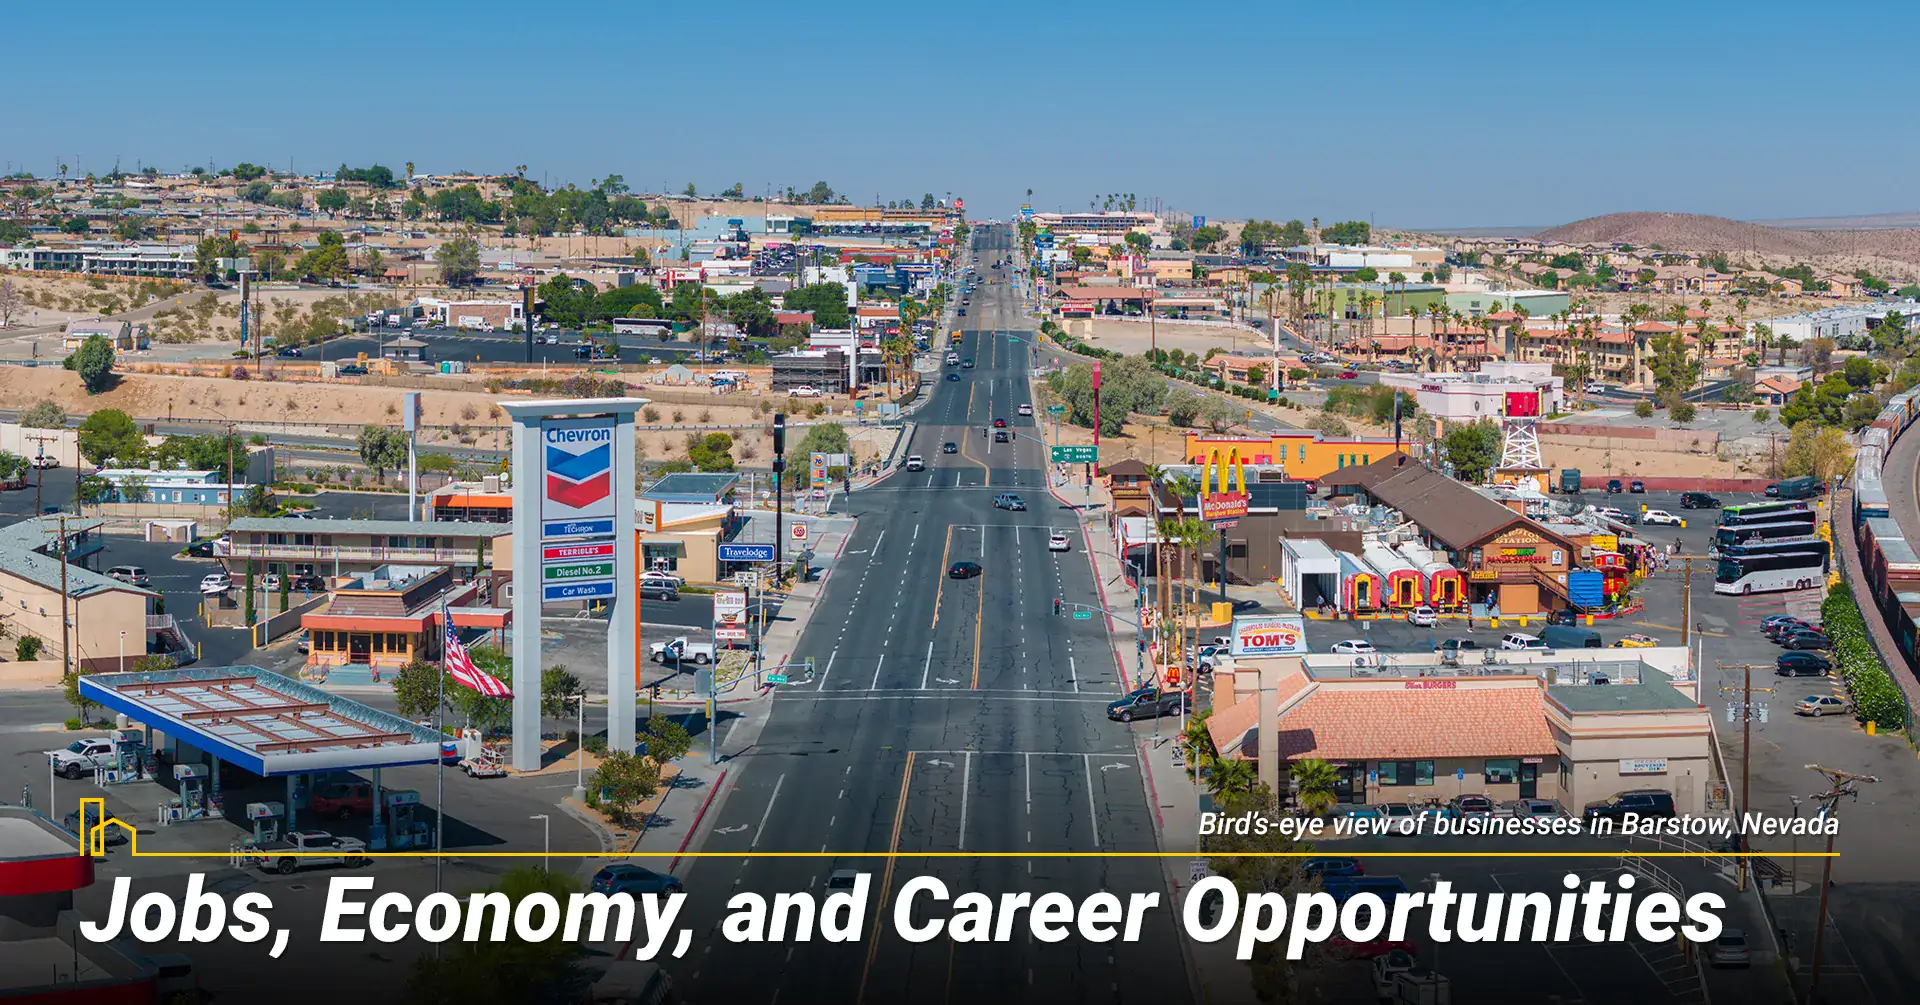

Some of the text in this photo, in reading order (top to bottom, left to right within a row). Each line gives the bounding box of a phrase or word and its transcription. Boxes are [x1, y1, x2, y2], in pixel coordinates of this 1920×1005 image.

[546, 427, 611, 443] Chevron
[1204, 499, 1247, 511] McDonald's
[559, 547, 599, 556] TERRIBLE'S
[724, 547, 768, 559] Travelodge
[1501, 547, 1536, 556] SUBWAY
[556, 566, 602, 577] Diesel No.2
[577, 586, 596, 594] Wash
[1240, 634, 1296, 647] TOM'S
[1423, 681, 1457, 689] BURGERS
